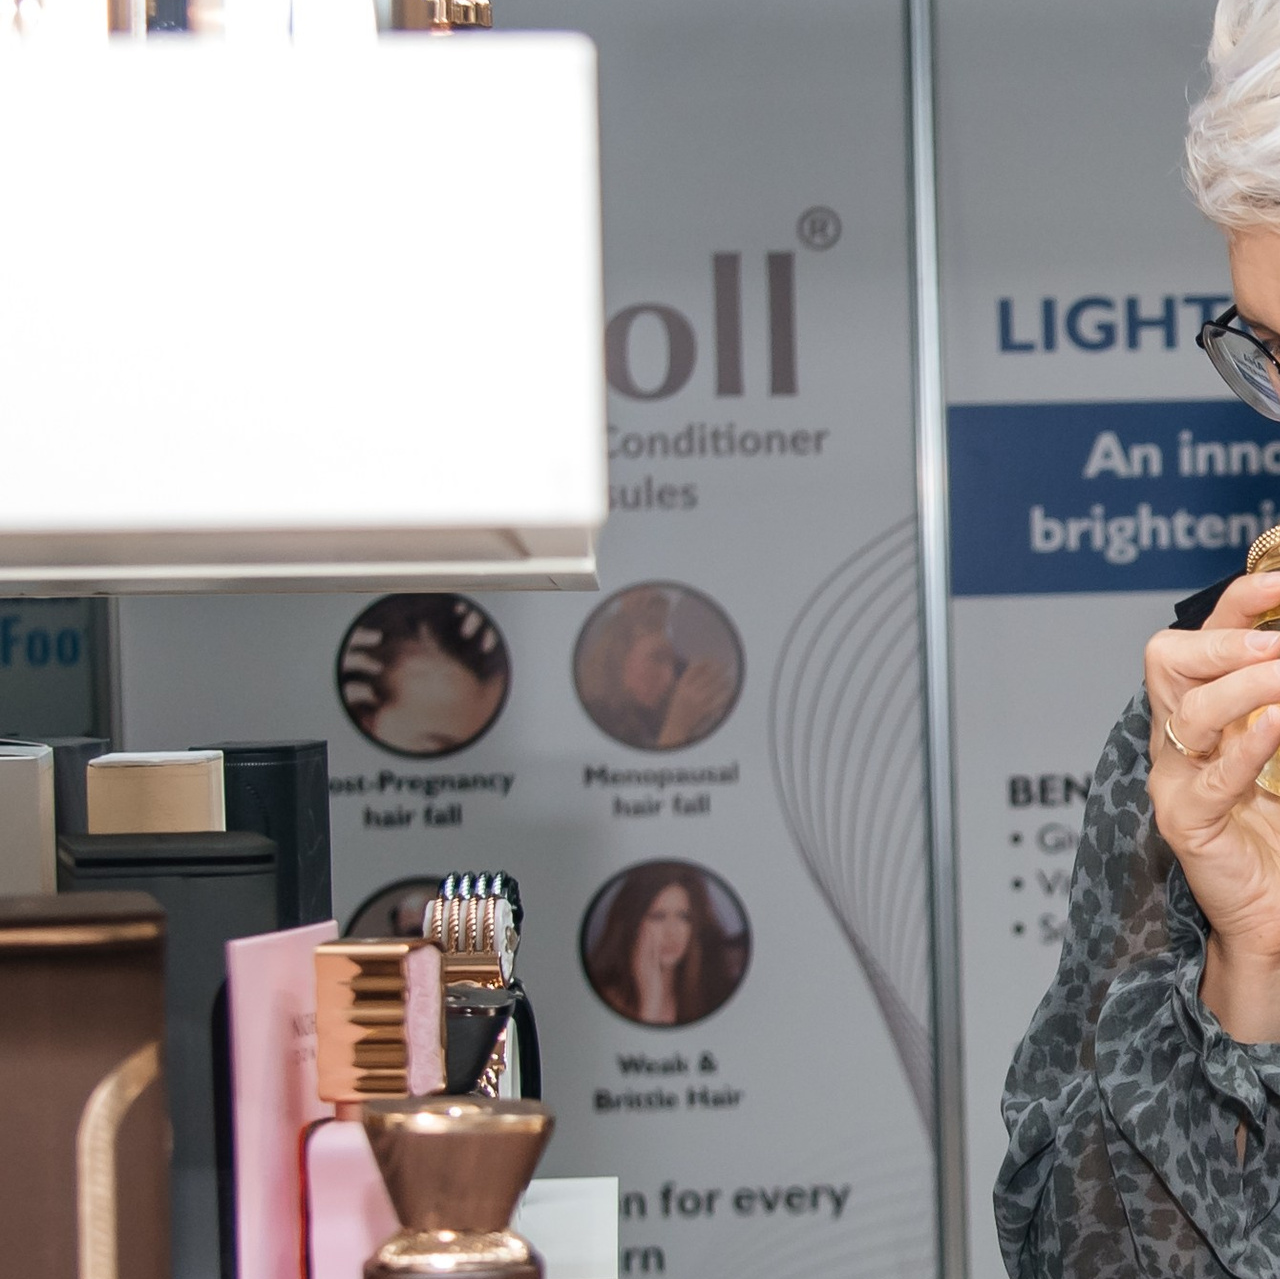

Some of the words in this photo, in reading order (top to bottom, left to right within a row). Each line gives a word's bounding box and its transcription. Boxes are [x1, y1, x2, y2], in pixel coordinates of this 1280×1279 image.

[1082, 429, 1163, 479] An
[583, 762, 741, 788] Menopausal
[363, 804, 415, 827] hair
[424, 803, 462, 827] fall
[612, 794, 661, 817] hair
[672, 792, 712, 816] fall
[685, 1084, 743, 1108] Hair
[659, 1180, 720, 1219] for
[731, 1182, 852, 1222] every
